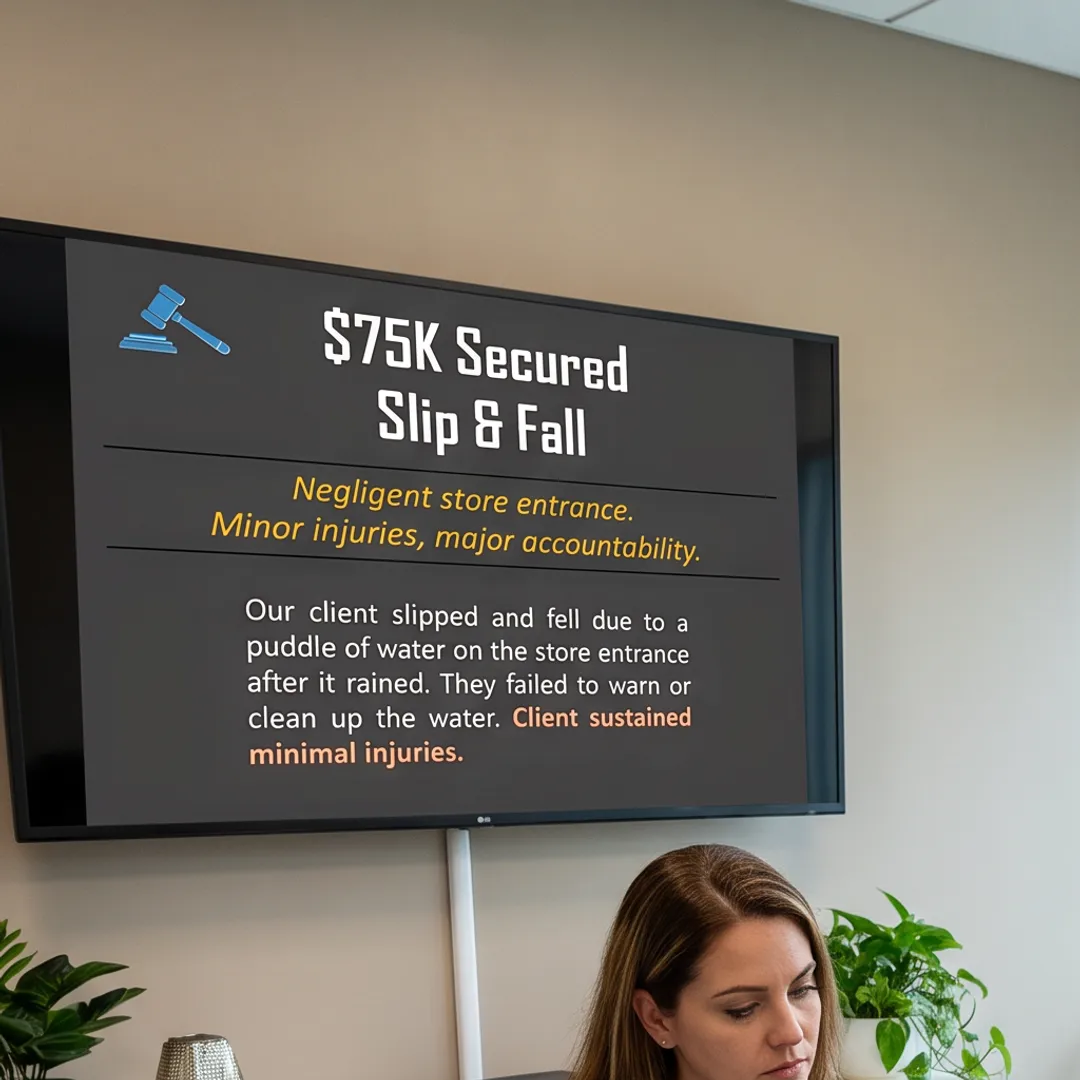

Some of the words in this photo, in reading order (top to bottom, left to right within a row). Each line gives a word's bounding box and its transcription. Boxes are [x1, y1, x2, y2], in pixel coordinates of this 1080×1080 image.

[323, 306, 443, 373] $75K
[456, 325, 629, 393] Secured
[377, 389, 459, 456] Slip
[474, 399, 504, 449] &
[517, 402, 586, 457] Fall
[292, 476, 434, 512] Negligent
[439, 489, 509, 513] store
[516, 495, 633, 521] entrance.
[211, 511, 305, 540] Minor
[313, 516, 425, 551] injuries,
[435, 526, 515, 556] major
[522, 535, 700, 567] accountability.
[245, 598, 296, 622] Our
[309, 599, 379, 624] client
[392, 602, 478, 632] slipped
[491, 606, 534, 628] and
[546, 606, 580, 630] fell
[592, 608, 632, 631] due
[643, 613, 665, 632] to
[677, 617, 688, 633] a
[247, 634, 337, 664] puddle
[344, 635, 372, 659] of
[376, 640, 446, 660] water
[453, 644, 483, 661] on
[490, 639, 528, 662] the
[535, 643, 591, 663] store
[598, 645, 690, 664] entrance
[247, 668, 309, 693] after
[319, 670, 336, 694] it
[347, 671, 430, 694] rained.
[439, 671, 497, 701] They
[505, 671, 568, 695] failed
[576, 676, 599, 695] to
[608, 680, 660, 696] warn
[669, 680, 692, 696] or
[248, 705, 316, 729] clean
[331, 712, 363, 736] up
[375, 705, 416, 729] the
[428, 709, 500, 729] water.
[512, 706, 579, 728] Client
[589, 706, 692, 728] sustained
[249, 741, 356, 765] minimal
[364, 740, 464, 769] injuries.
